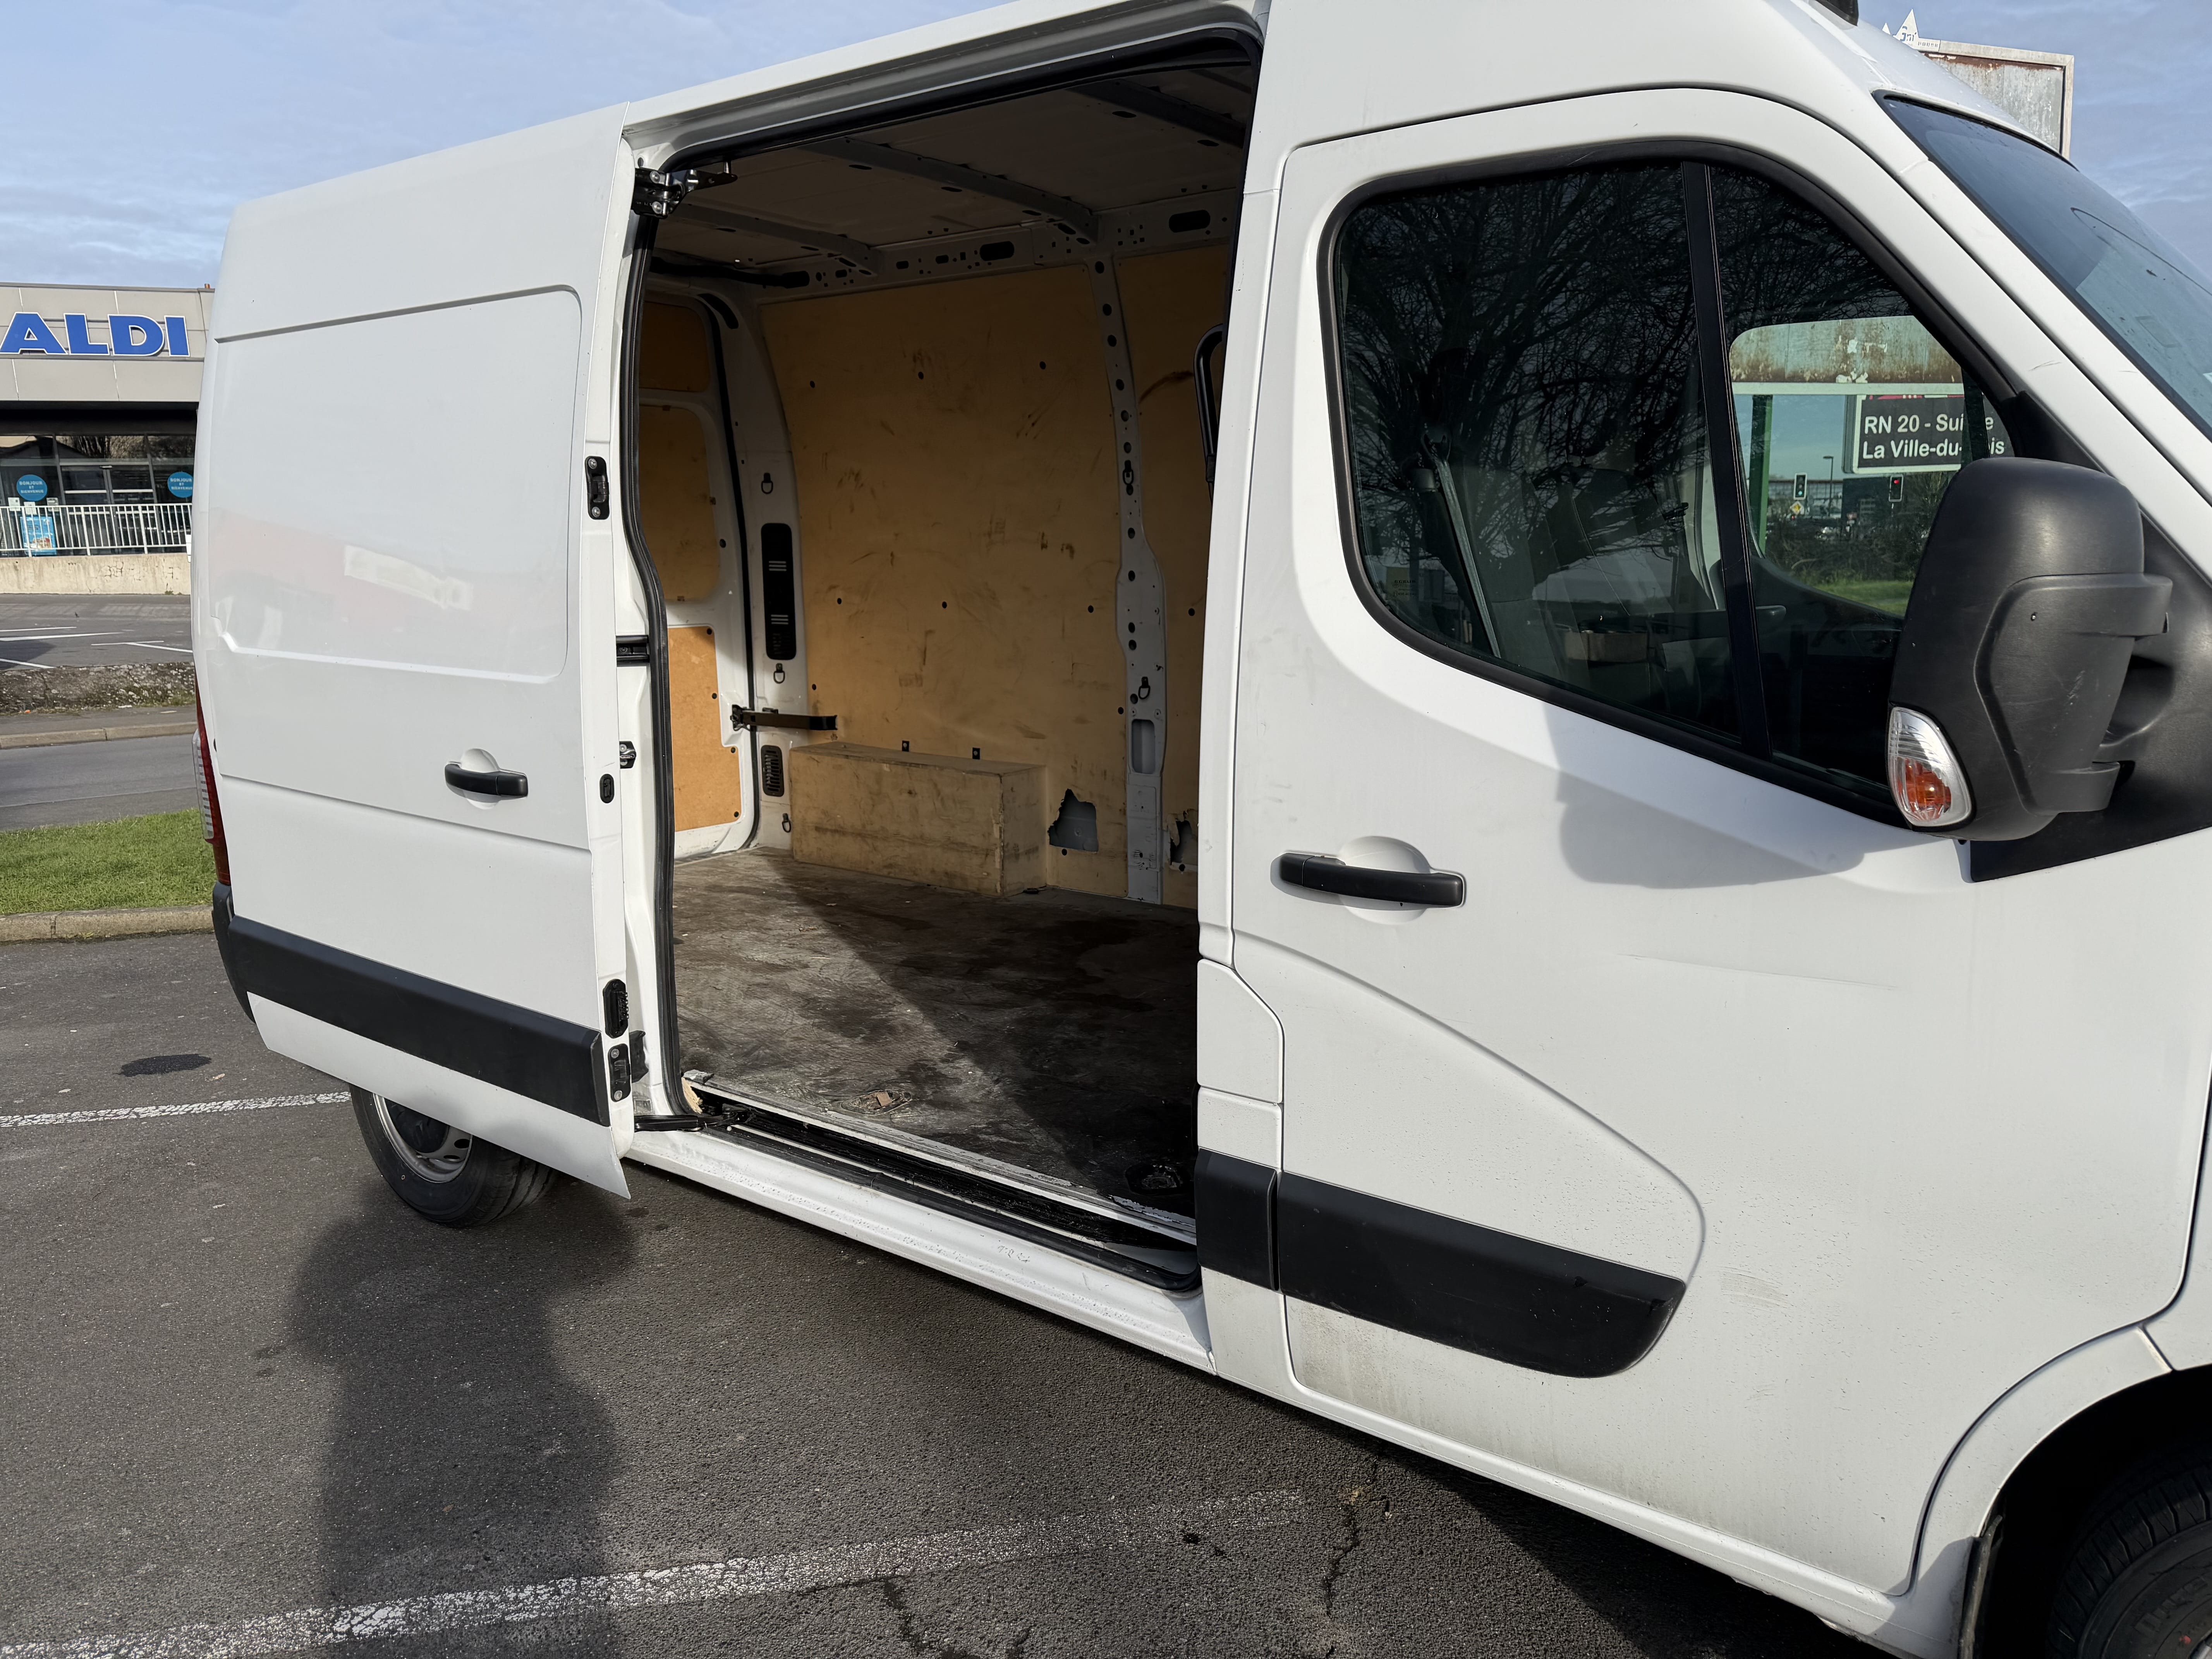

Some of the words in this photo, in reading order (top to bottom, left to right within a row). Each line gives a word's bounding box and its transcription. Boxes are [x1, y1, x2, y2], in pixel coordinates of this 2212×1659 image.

[0, 312, 190, 357] ALDI
[1865, 416, 1892, 434] RN
[1898, 414, 1920, 433] 20
[1936, 413, 1994, 432] Suie
[1863, 441, 1885, 459] La
